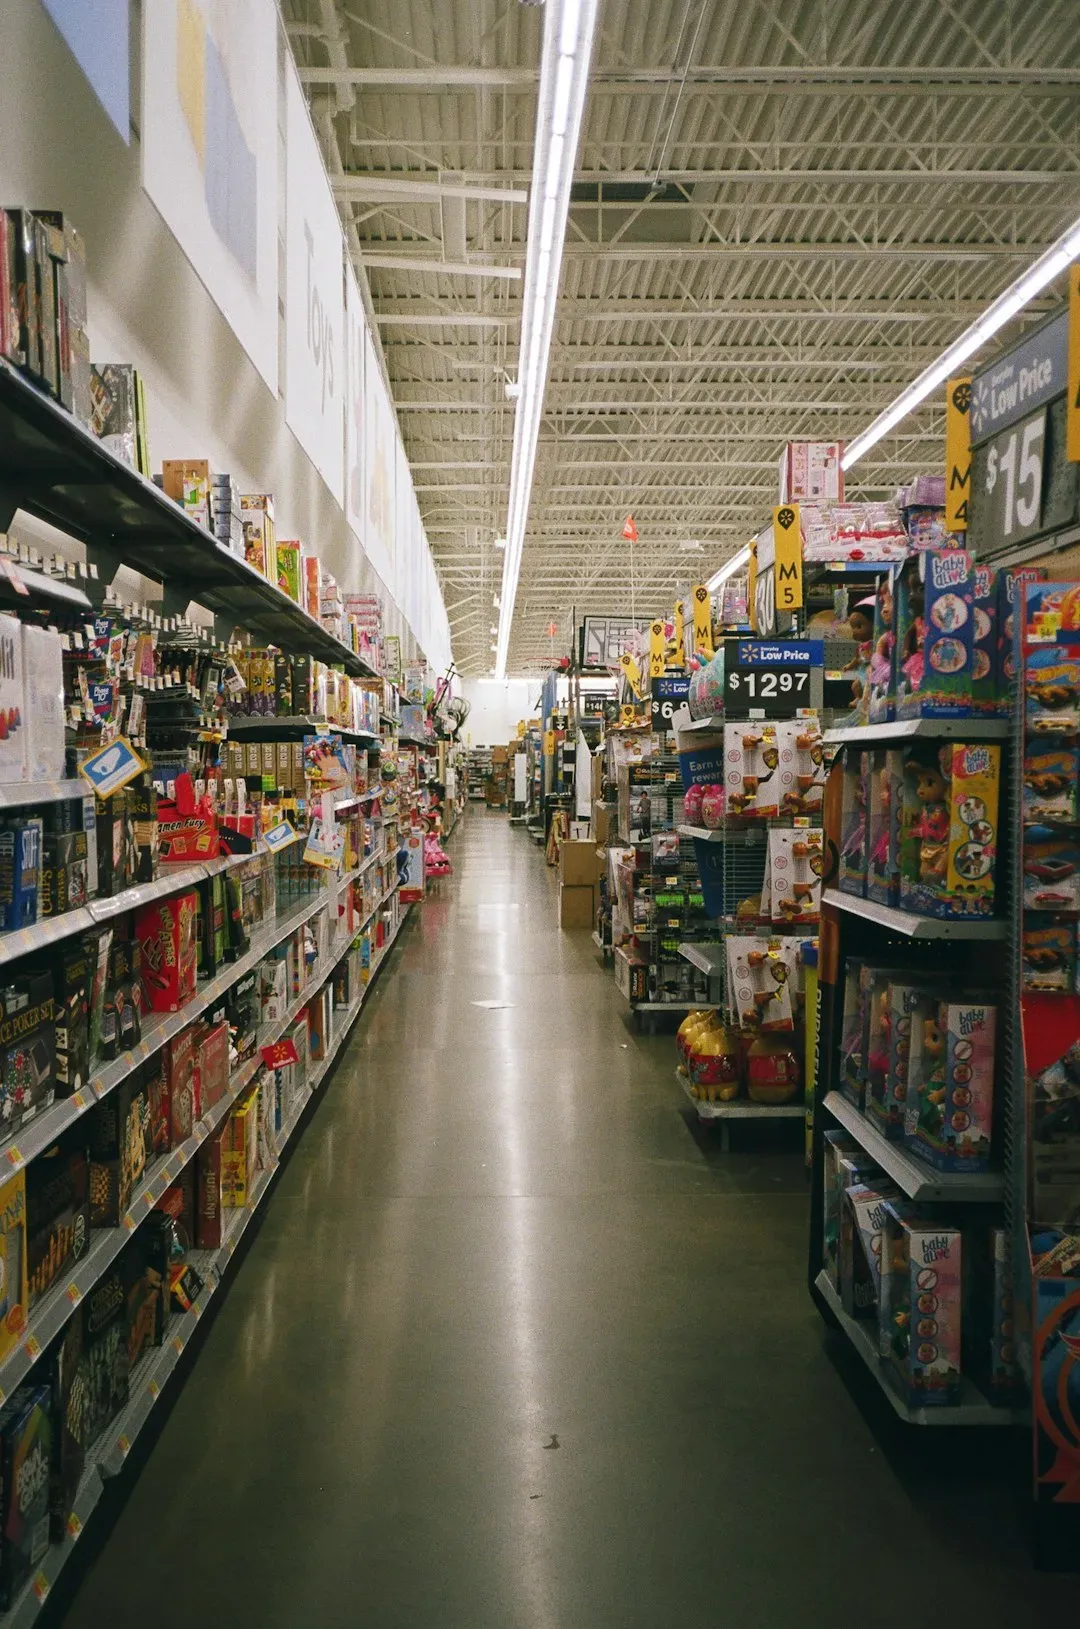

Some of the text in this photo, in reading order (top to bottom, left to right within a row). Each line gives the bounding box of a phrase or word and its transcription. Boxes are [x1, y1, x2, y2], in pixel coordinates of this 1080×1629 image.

[303, 216, 335, 416] Toys
[990, 358, 1053, 420] Low Price
[950, 465, 971, 491] M
[986, 414, 1046, 537] $15
[954, 500, 969, 523] 4
[779, 562, 798, 581] M
[933, 555, 965, 576] baby
[755, 569, 775, 637] 30
[784, 587, 794, 604] 5
[95, 618, 109, 629] Phase
[697, 626, 709, 639] M
[652, 653, 663, 663] M
[760, 650, 810, 660] Low Price
[653, 666, 660, 675] 9
[94, 686, 109, 695] Phase
[96, 693, 106, 701] 10
[673, 685, 689, 693] Low
[689, 760, 714, 772] Earn
[158, 817, 205, 833] amen Fury
[37, 868, 53, 914] CHIPS
[13, 1006, 41, 1036] POKER
[40, 997, 56, 1021] SET
[959, 1008, 984, 1025] baby
[199, 1168, 217, 1219] JUMANJI
[921, 1236, 949, 1253] baby
[923, 1248, 951, 1264] alive
